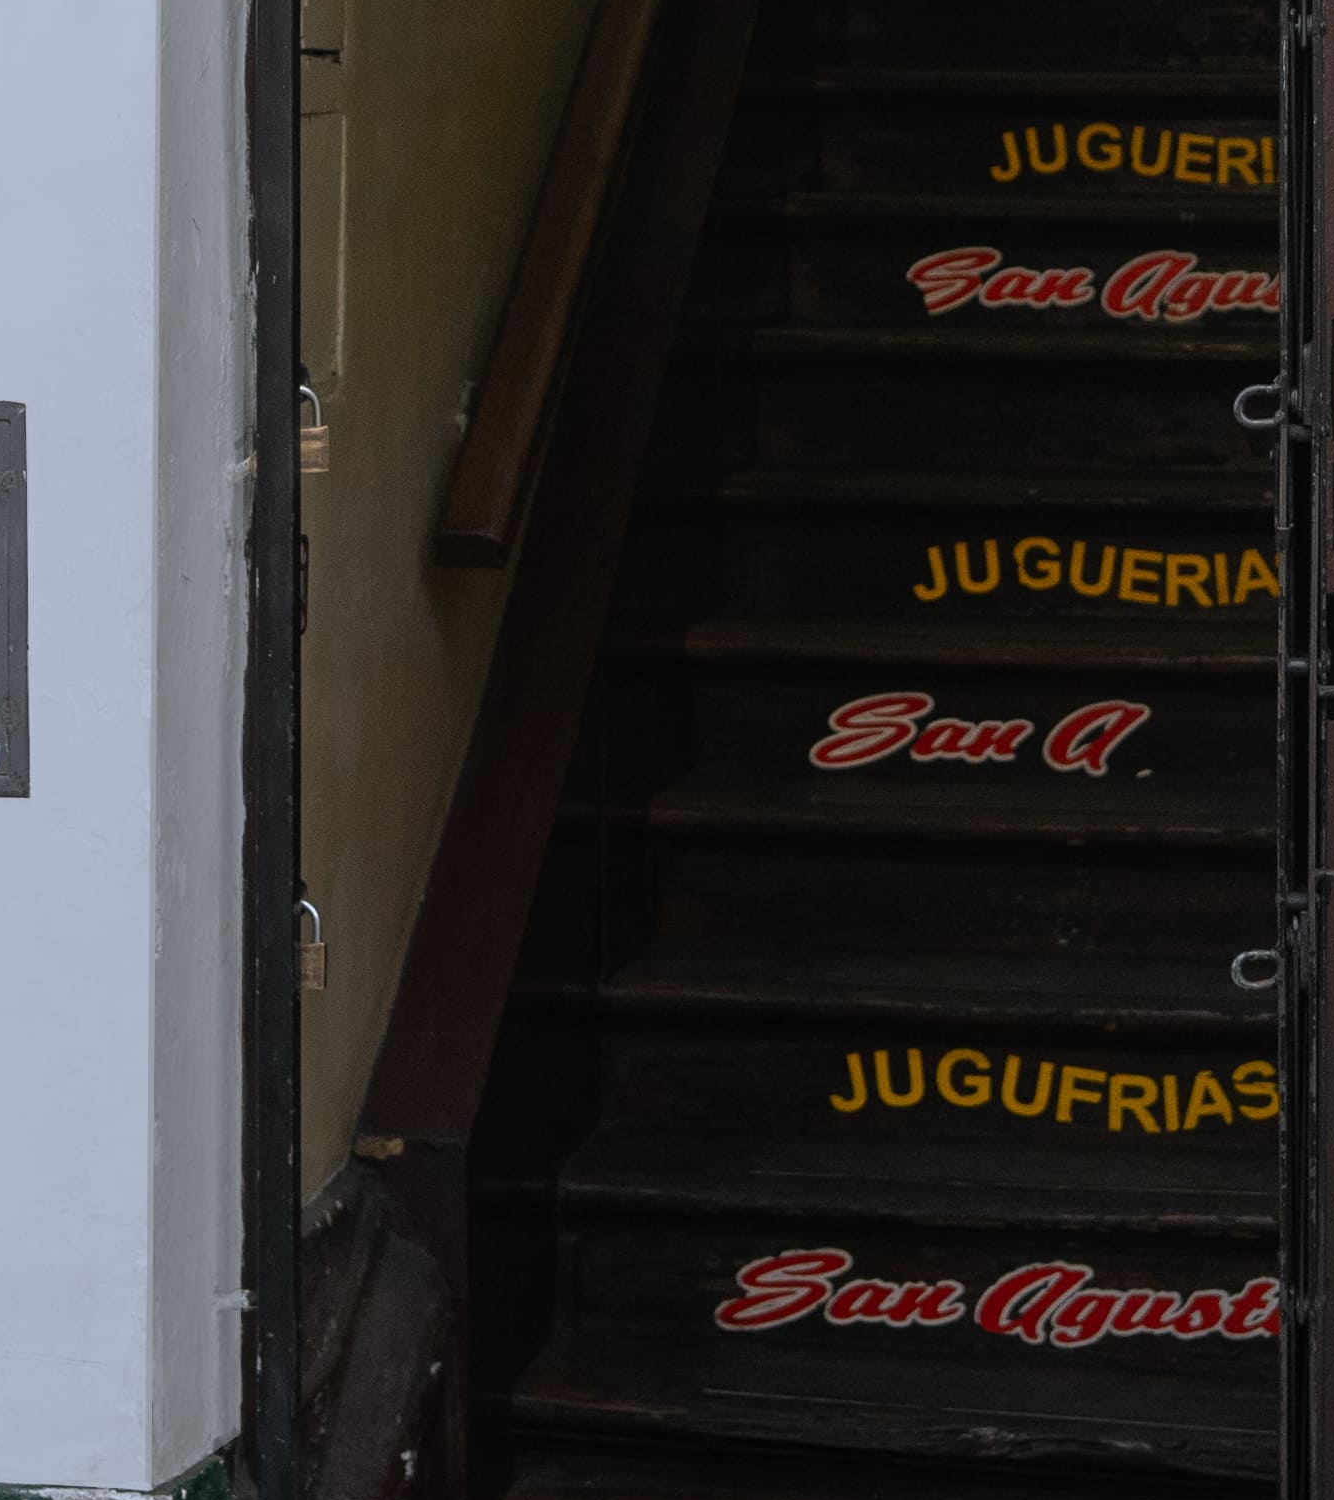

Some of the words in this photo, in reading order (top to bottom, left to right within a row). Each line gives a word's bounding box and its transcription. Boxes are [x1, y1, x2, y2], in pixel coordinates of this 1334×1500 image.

[990, 123, 1276, 184] JUGUERI
[907, 246, 1095, 316] San
[913, 537, 1280, 607] JUGUERIA
[810, 692, 1033, 768] San
[1043, 702, 1150, 777] A
[715, 1250, 965, 1331] San
